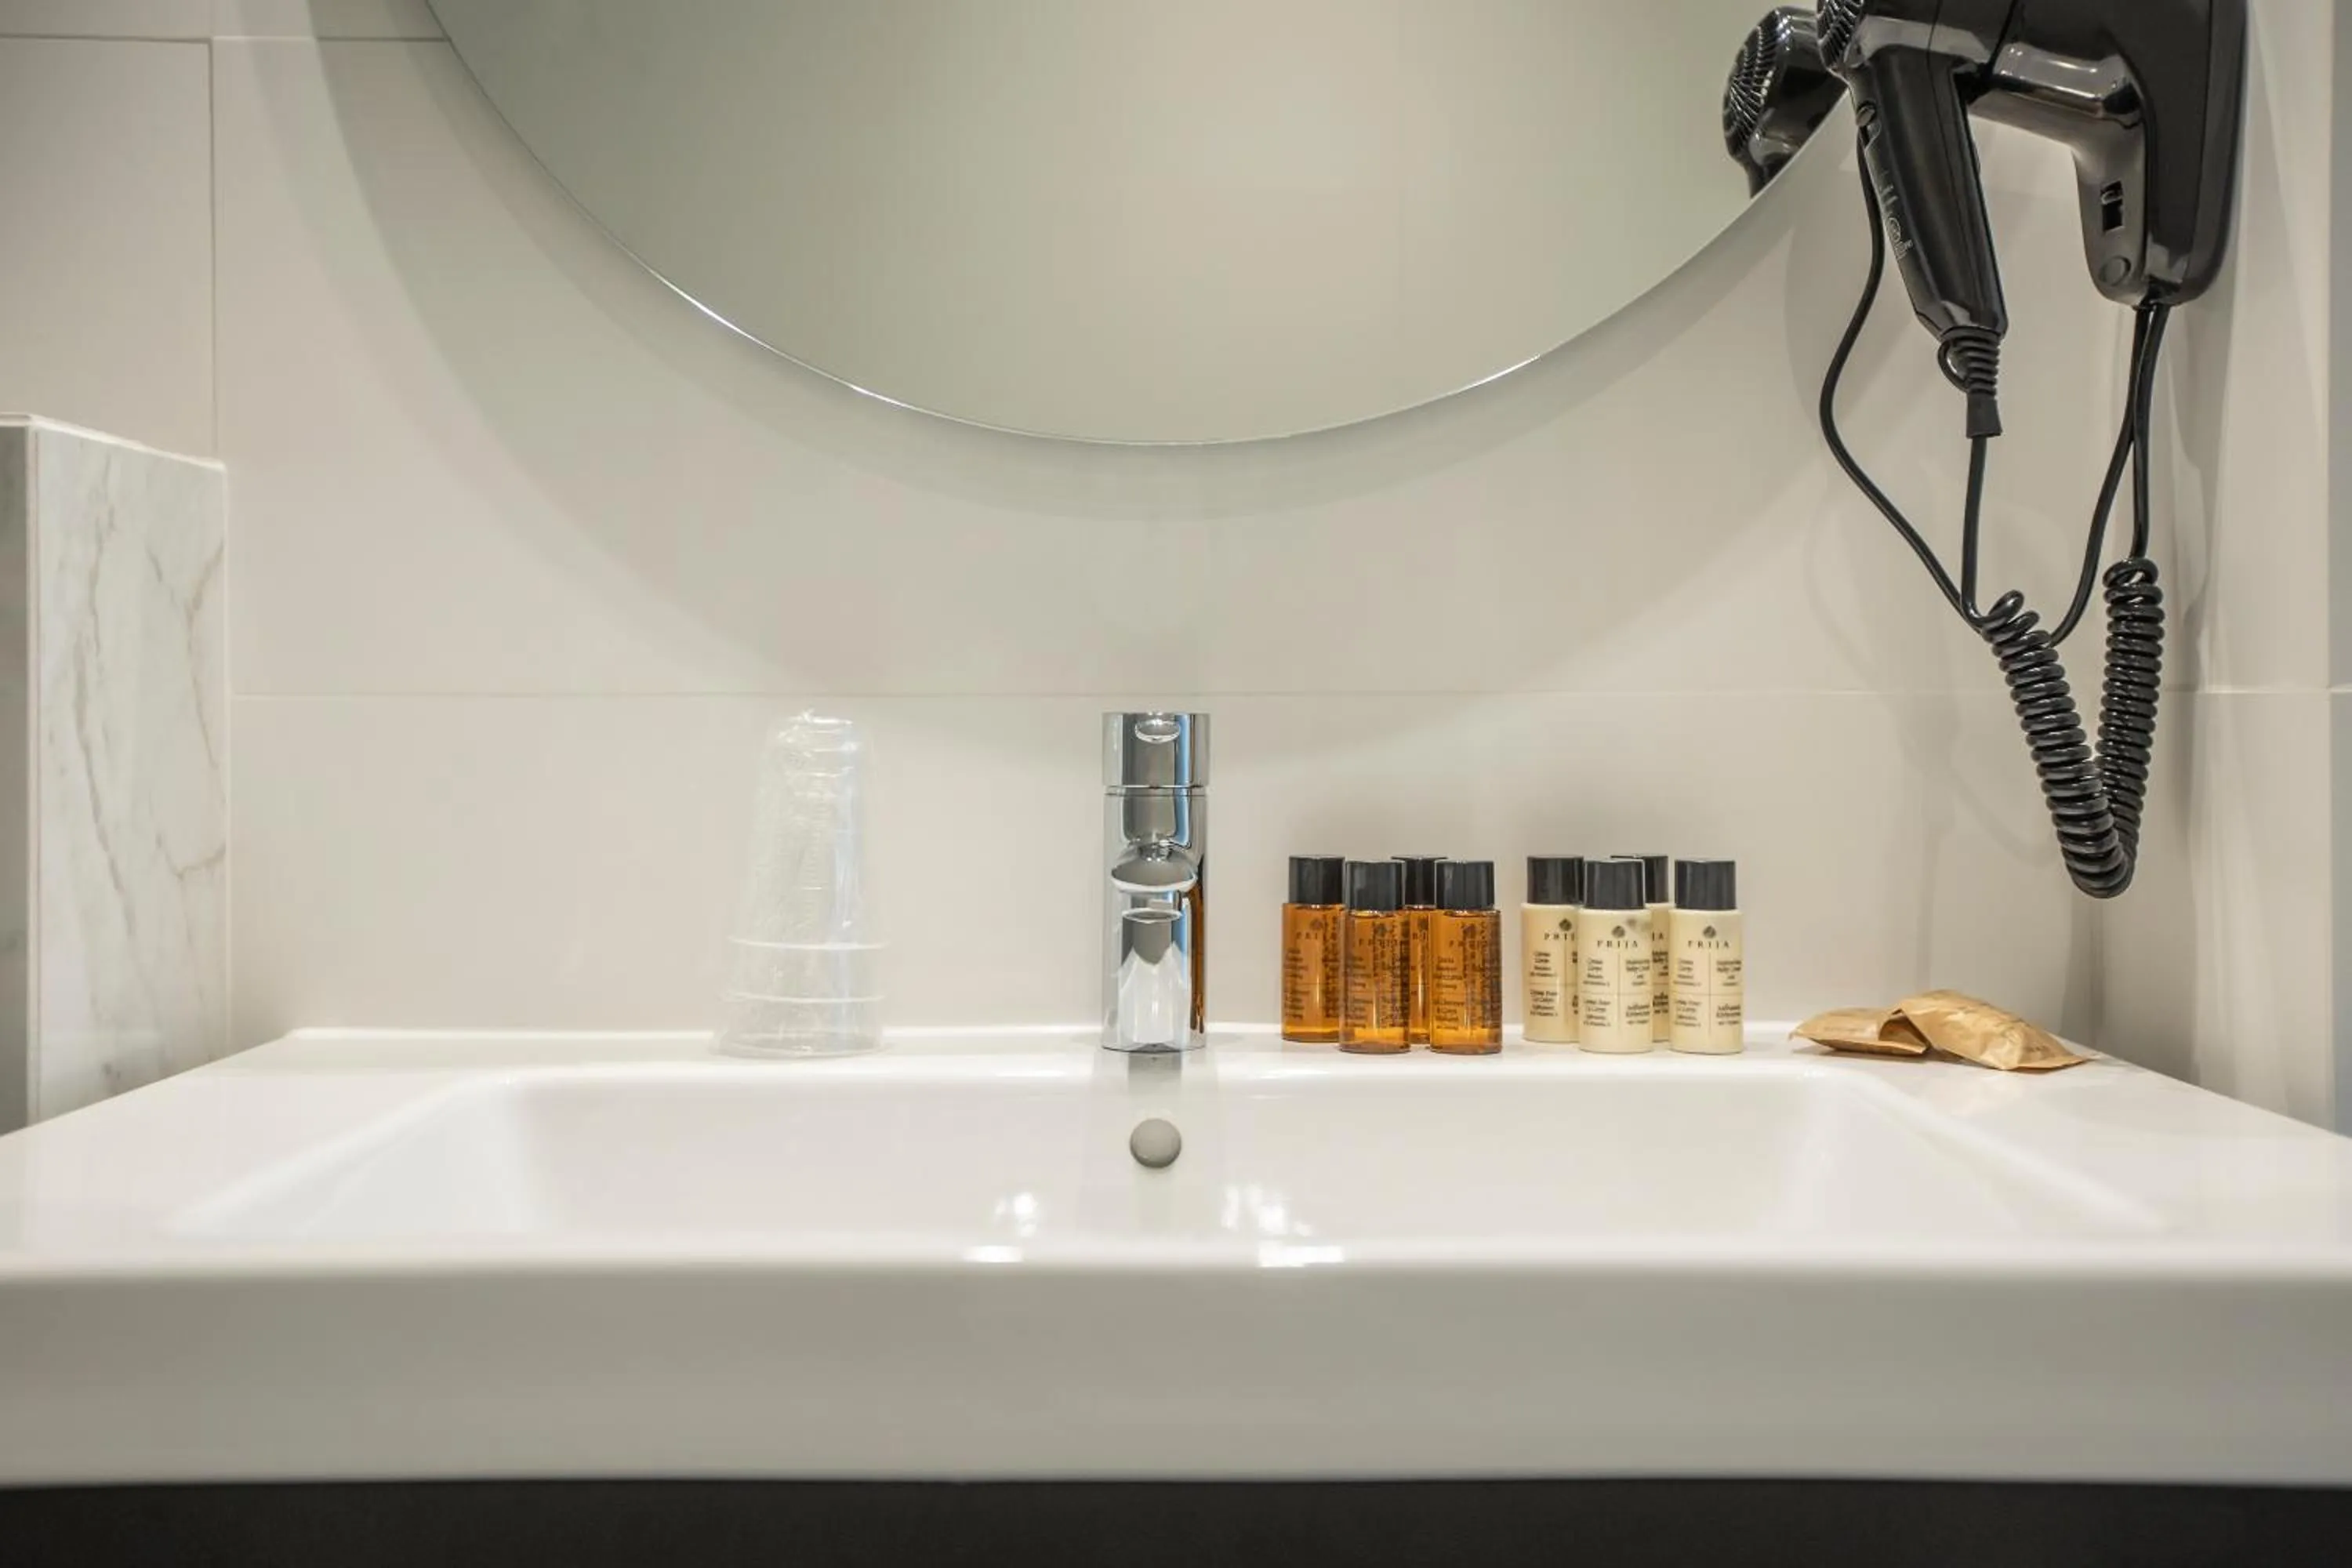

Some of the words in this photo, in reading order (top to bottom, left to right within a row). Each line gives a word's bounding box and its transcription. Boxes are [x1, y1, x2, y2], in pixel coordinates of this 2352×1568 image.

[1543, 932, 1575, 942] PRIJ
[1597, 940, 1639, 949] PRIJA
[1687, 940, 1730, 949] PRIJA
